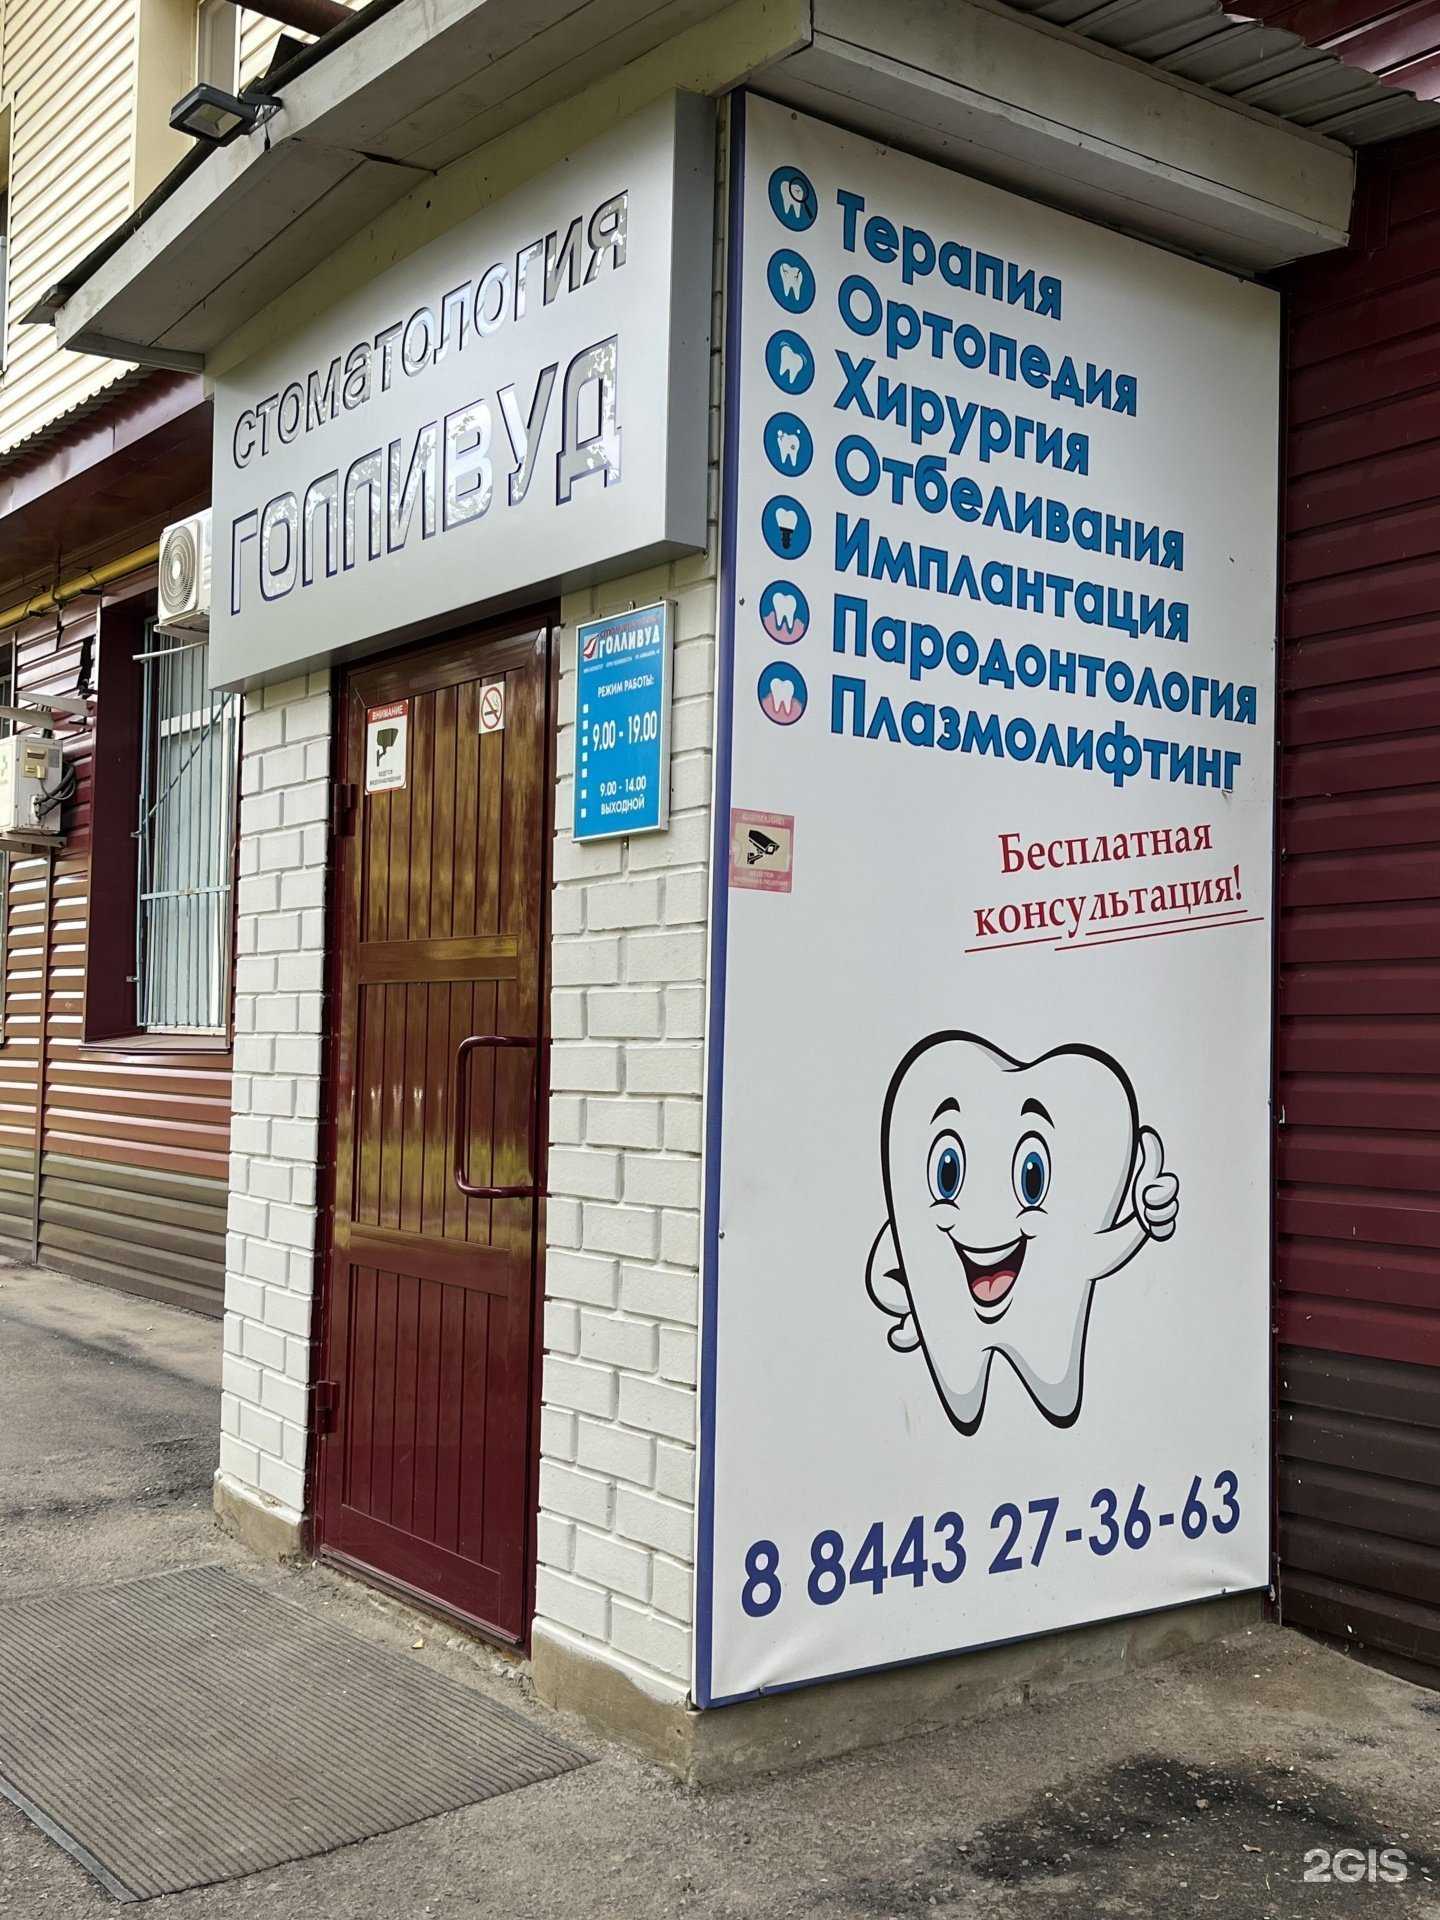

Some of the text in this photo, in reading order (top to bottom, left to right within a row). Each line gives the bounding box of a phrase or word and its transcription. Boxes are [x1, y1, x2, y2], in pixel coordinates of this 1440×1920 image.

[837, 188, 1062, 320] Терапия
[838, 274, 1137, 417] Ортопедия
[833, 349, 1089, 476] Хирургия
[231, 334, 623, 616] ГОЛЛИВУД
[835, 434, 1184, 571] Отбеливания
[834, 512, 1189, 642] Имплантация
[597, 682, 624, 698] РЕЖИМ
[599, 624, 660, 659] ГОЛЛИВУД
[832, 593, 1257, 725] Пародонтология
[592, 720, 616, 752] 9.00
[628, 710, 657, 745] 19.00
[600, 780, 617, 798] 9.00
[625, 775, 647, 793] 14.00
[830, 674, 1241, 789] Плазмолифтинг
[601, 794, 645, 816] ВЫХОДНОЙ
[998, 824, 1213, 874] Бесплатная
[973, 864, 1242, 938] консультация!
[741, 1469, 1241, 1618] 8 8443 27-36-63
